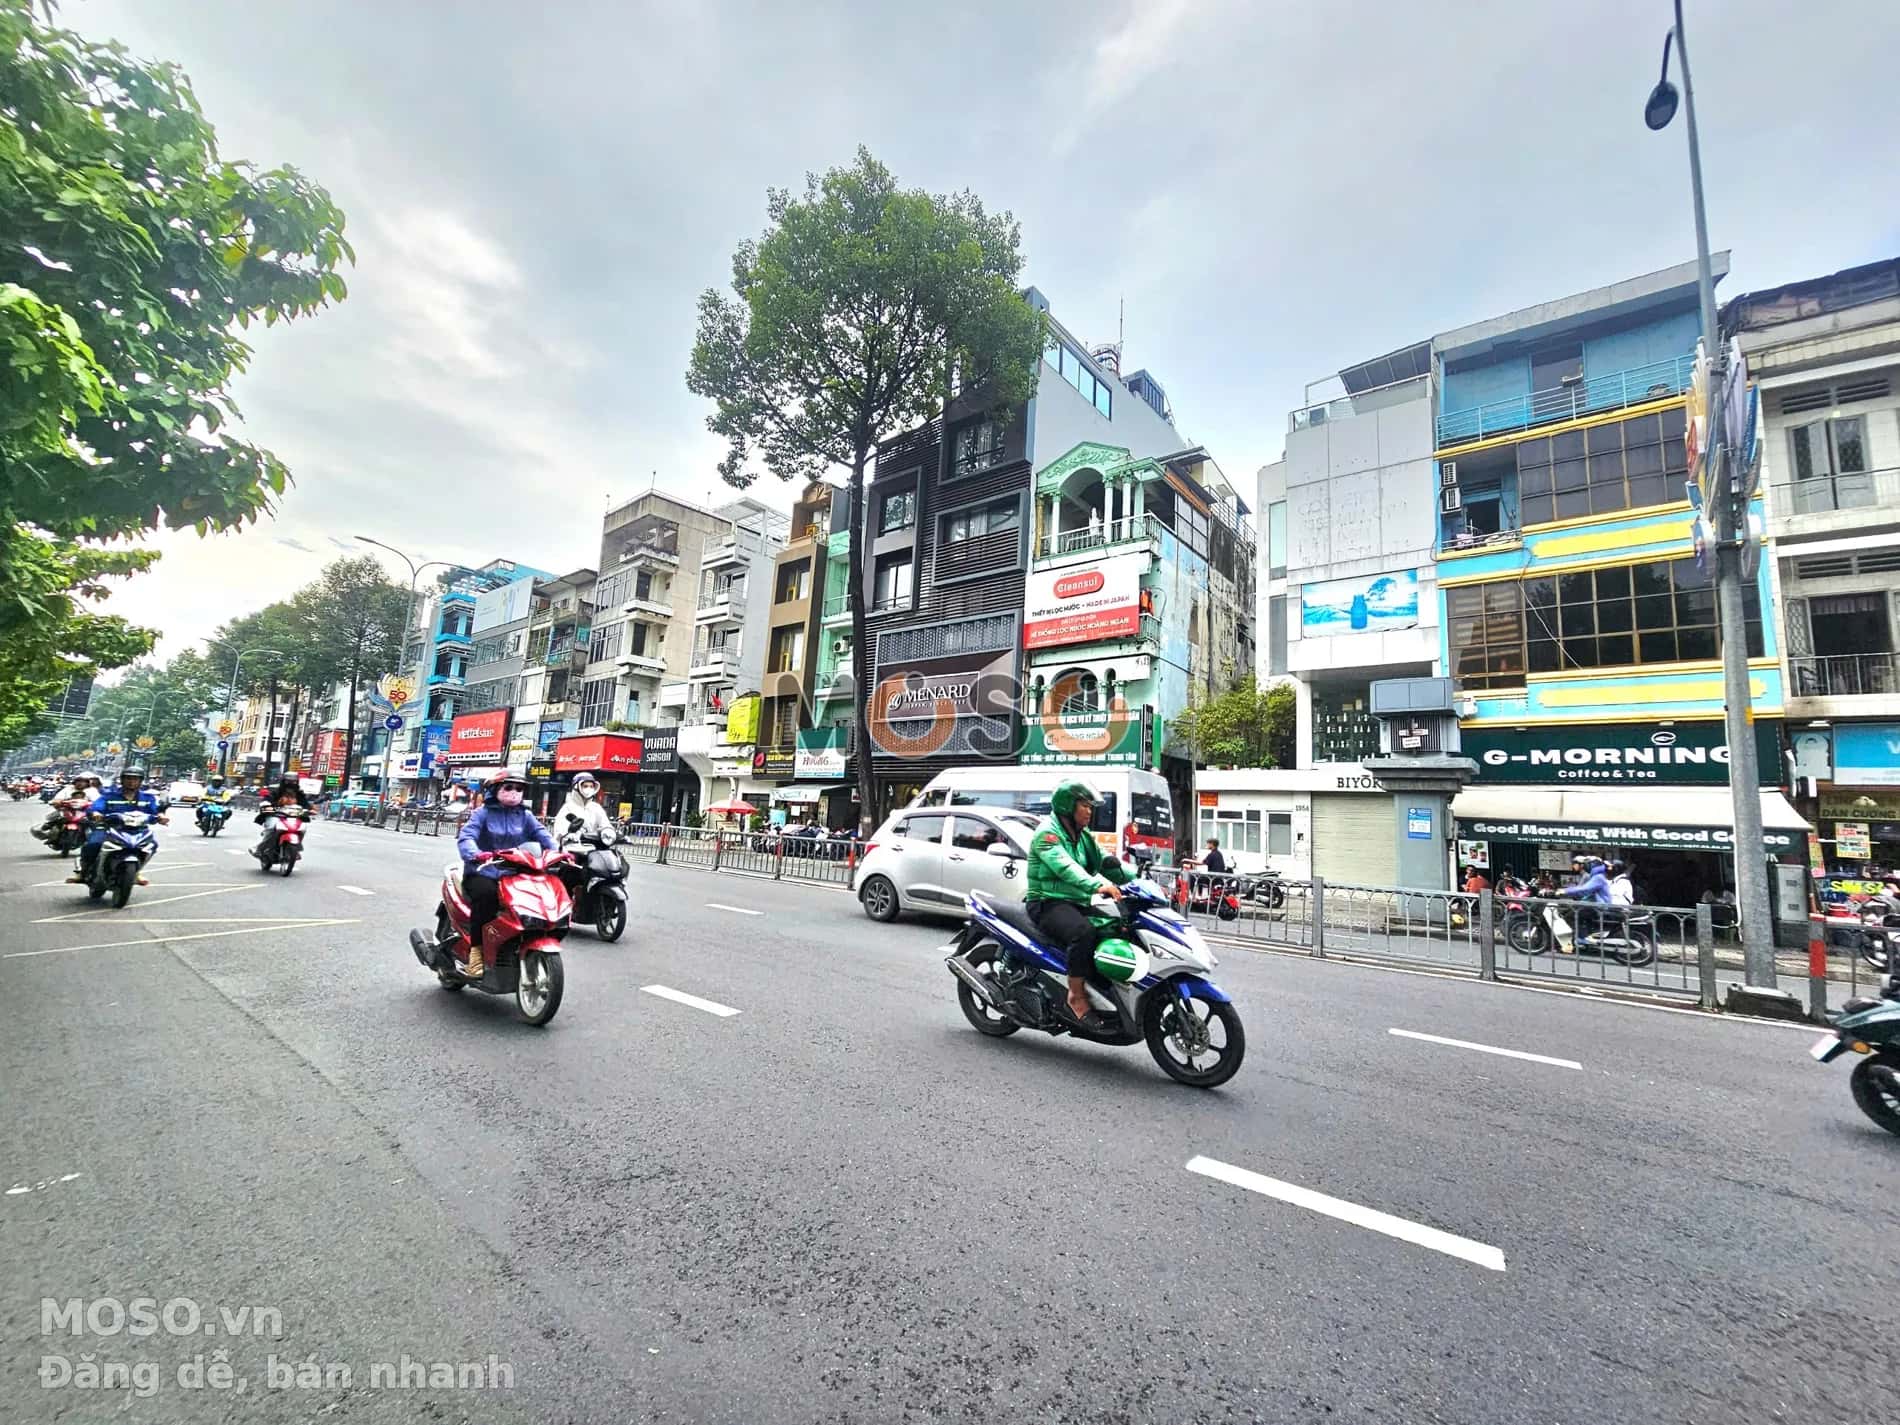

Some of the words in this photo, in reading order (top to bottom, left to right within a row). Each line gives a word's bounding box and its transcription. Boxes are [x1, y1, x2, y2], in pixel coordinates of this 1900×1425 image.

[904, 683, 971, 703] MENARD
[1558, 769, 1611, 779] Coffee
[1612, 769, 1623, 779] &
[1627, 769, 1657, 779] Tea
[1473, 822, 1519, 835] Good
[1521, 824, 1600, 840] Morning
[1601, 826, 1648, 841] With
[1651, 828, 1709, 842] Good
